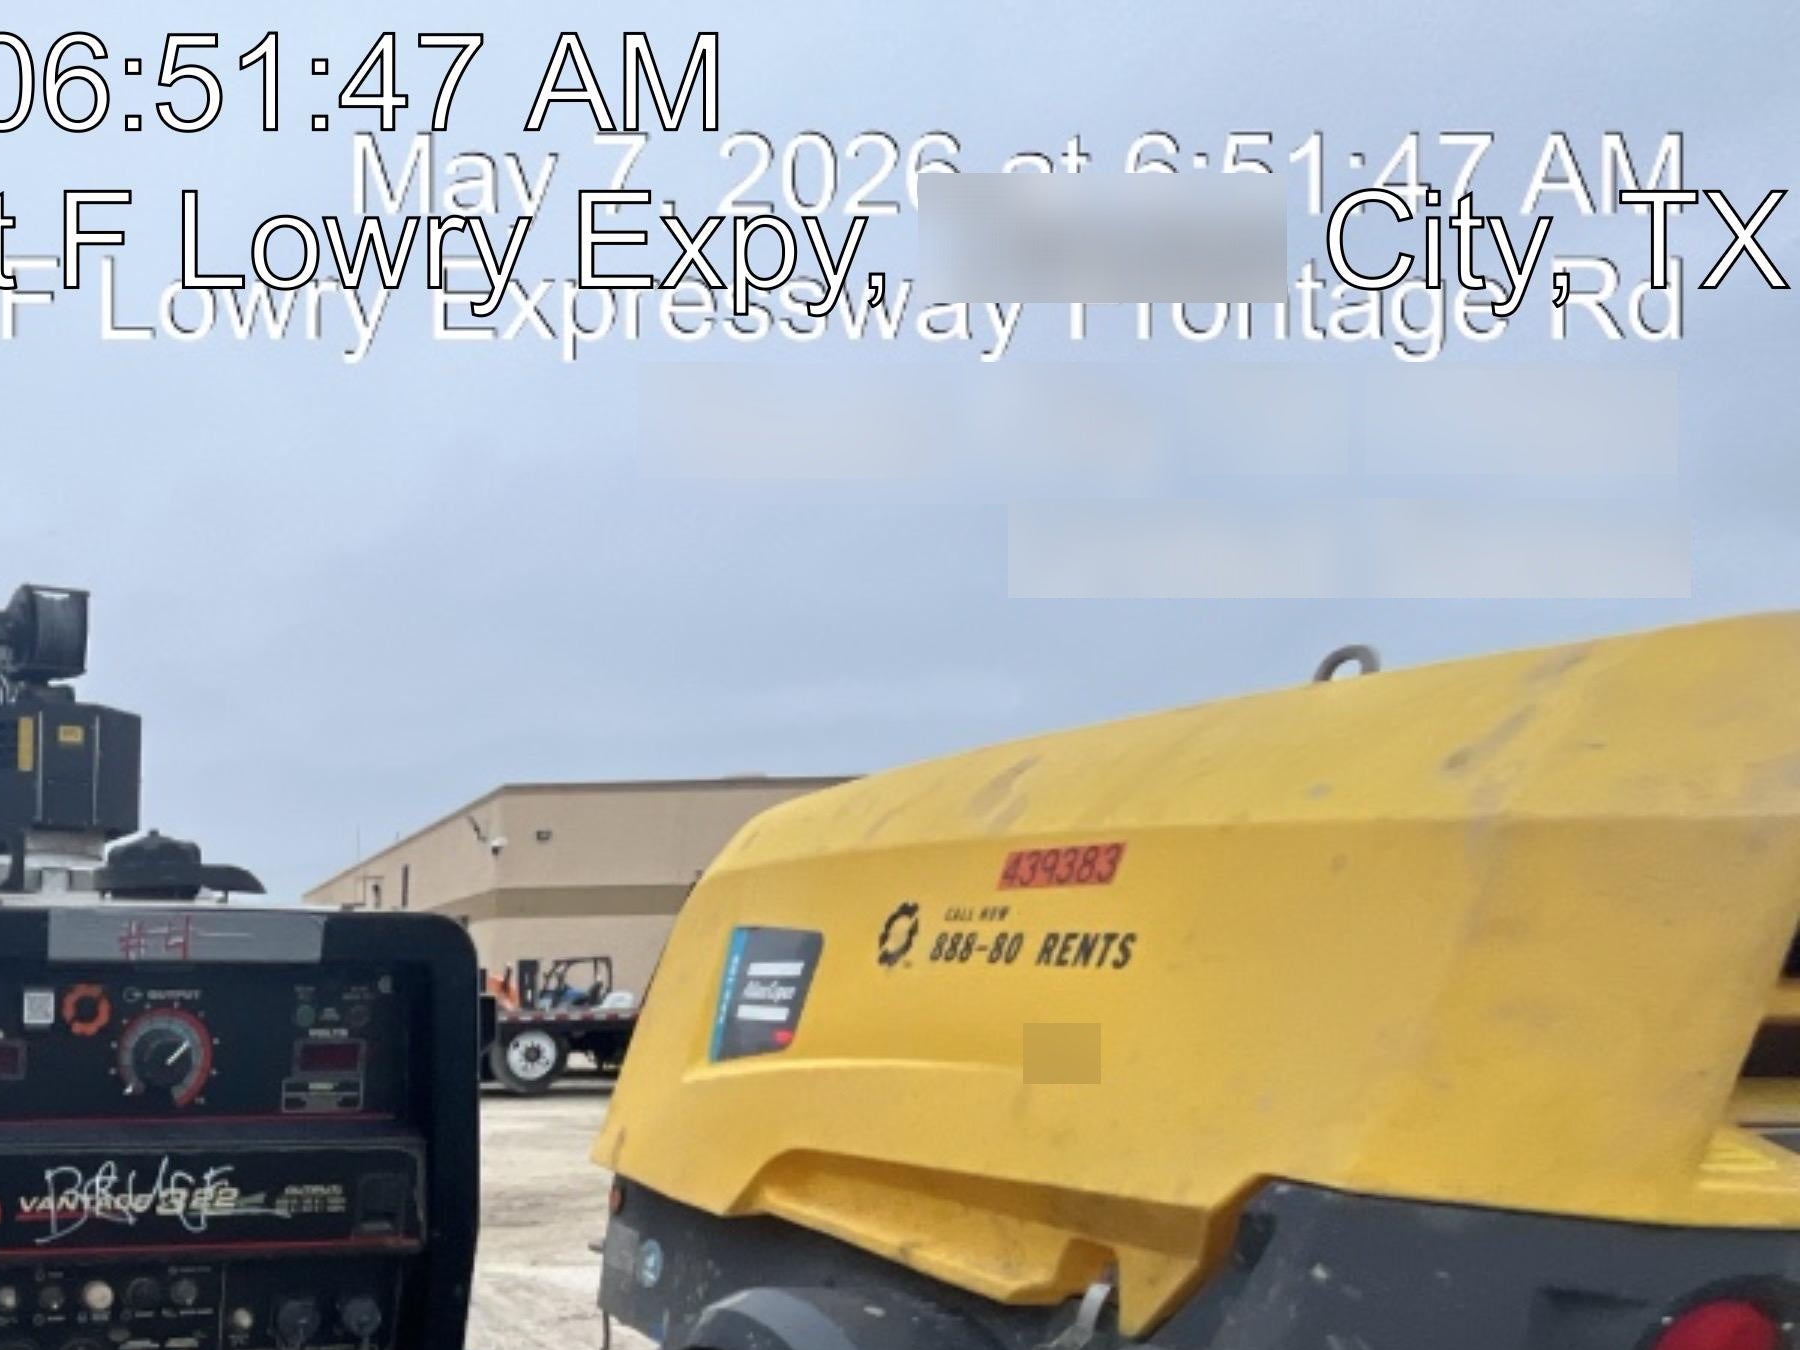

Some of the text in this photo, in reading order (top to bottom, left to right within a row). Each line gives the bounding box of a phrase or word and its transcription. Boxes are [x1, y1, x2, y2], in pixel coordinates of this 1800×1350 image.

[1001, 844, 1124, 888] 439383
[929, 931, 1138, 970] 888-80 RENTS
